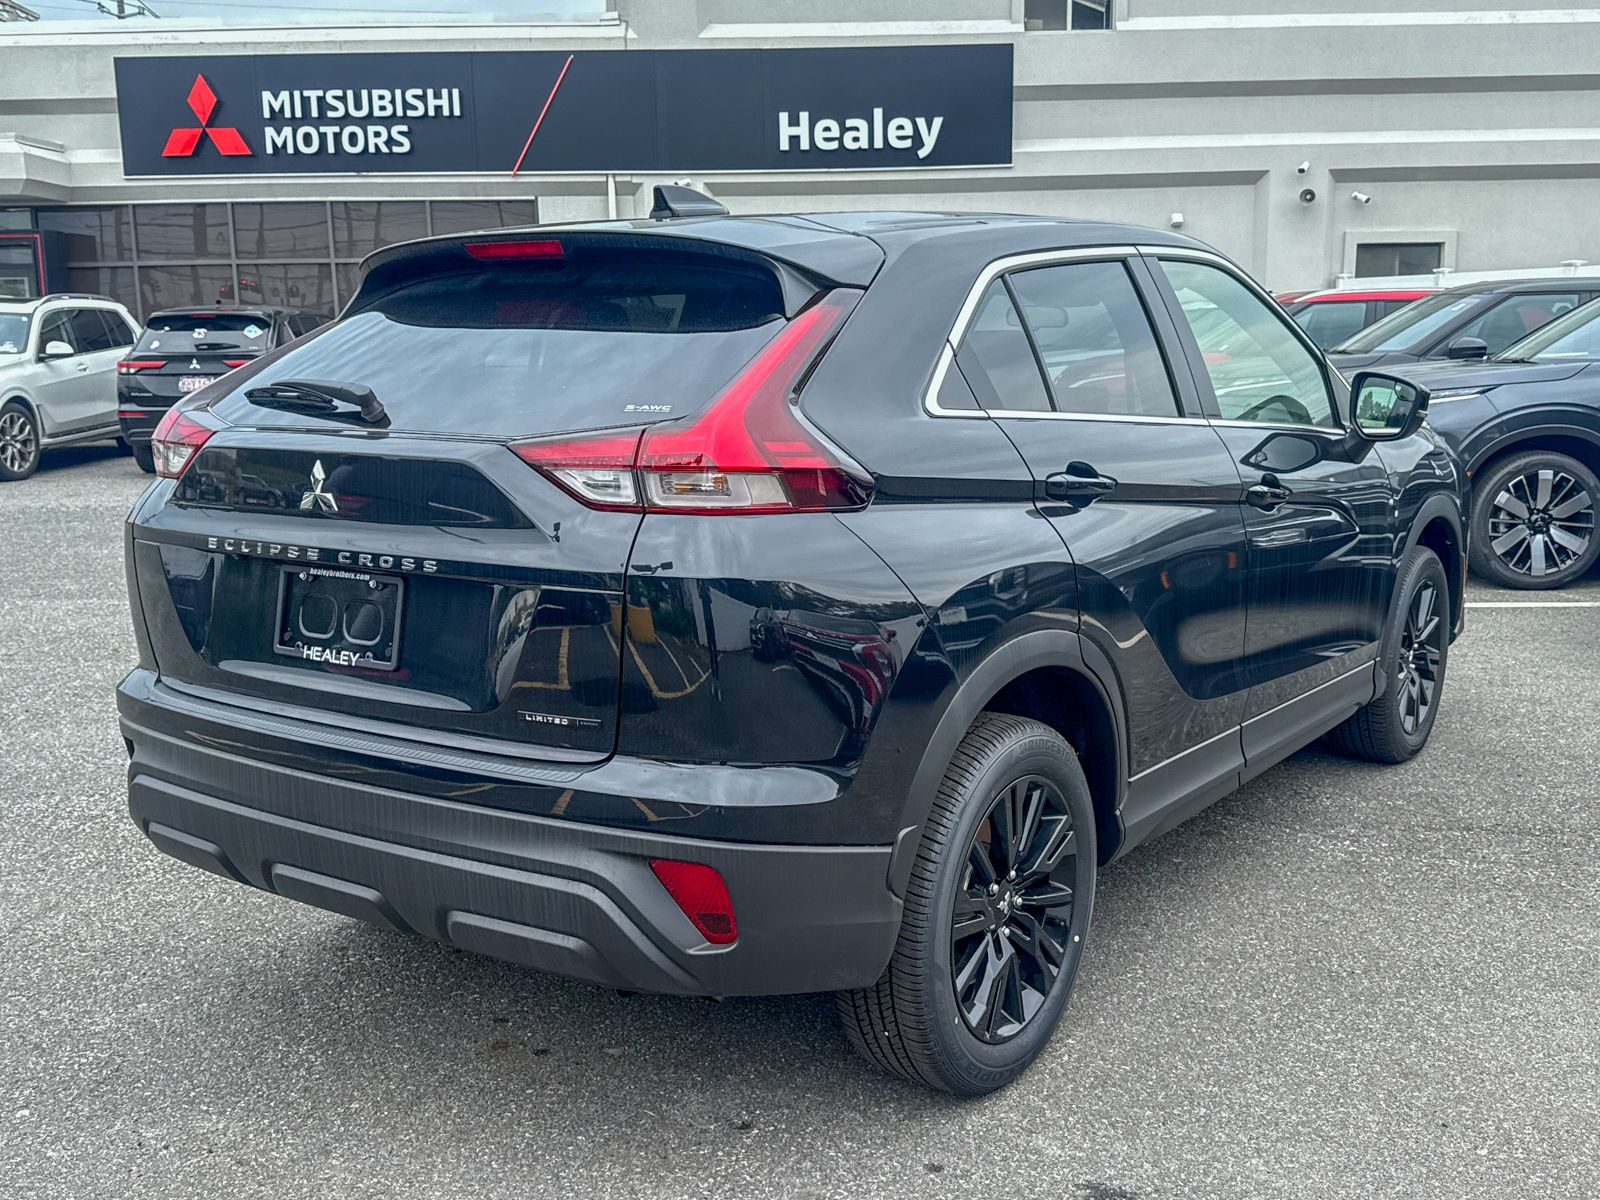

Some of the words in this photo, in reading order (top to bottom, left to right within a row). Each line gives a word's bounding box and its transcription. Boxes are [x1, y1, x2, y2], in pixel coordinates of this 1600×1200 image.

[262, 88, 461, 118] MITSUBISHI
[264, 125, 411, 154] MOTORS
[778, 107, 944, 159] Healey
[623, 404, 672, 412] S-AWC
[208, 537, 320, 561] ECLIPSE
[338, 552, 438, 573] CROSS
[310, 567, 370, 581] healeybrothers.com
[303, 645, 361, 666] HEALEY
[525, 714, 569, 725] LIMITED
